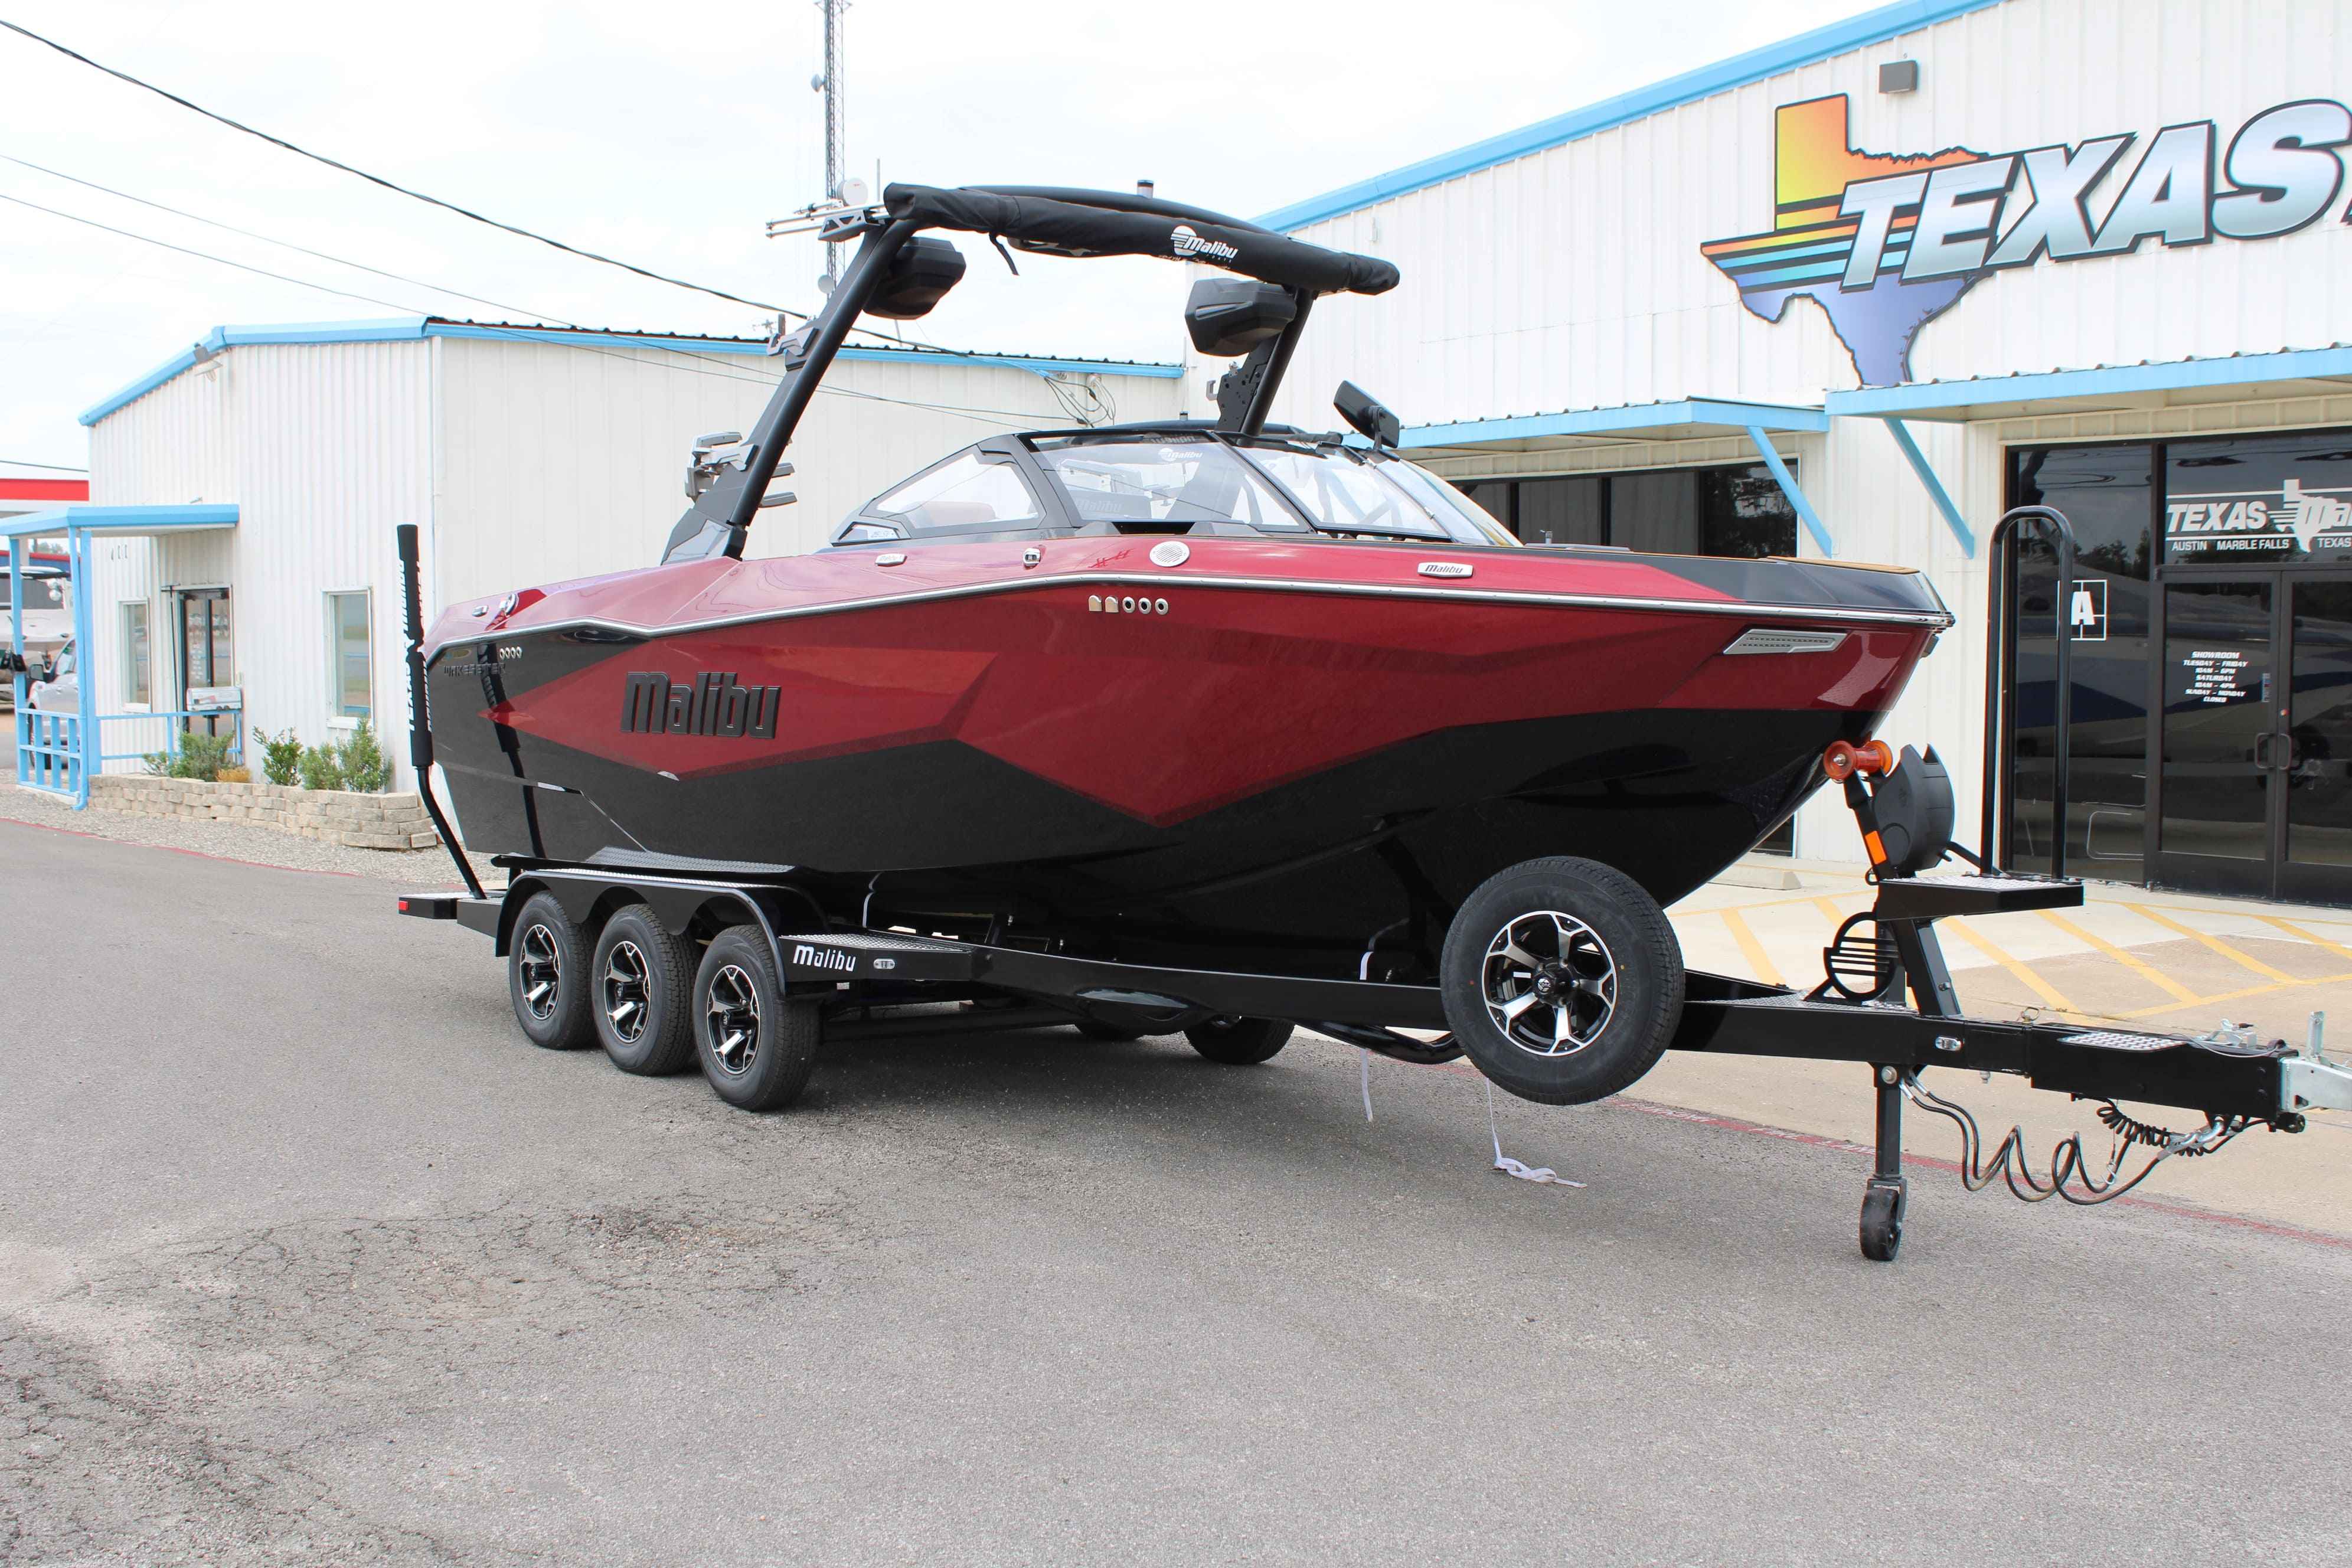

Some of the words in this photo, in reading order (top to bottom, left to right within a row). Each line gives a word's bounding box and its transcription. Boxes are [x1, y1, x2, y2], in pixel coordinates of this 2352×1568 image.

[1838, 99, 2352, 293] TEXAS
[1182, 236, 1239, 259] Malibu
[2166, 501, 2268, 533] TEXAS
[2172, 540, 2207, 551] AUSTIN
[2216, 539, 2259, 551] MARBLE
[2259, 538, 2289, 550] FALLS
[2317, 537, 2352, 548] TEXAS
[1424, 565, 1464, 574] Malibu
[2070, 591, 2096, 625] A
[620, 671, 782, 739] Malibu
[792, 945, 857, 972] Malibu
